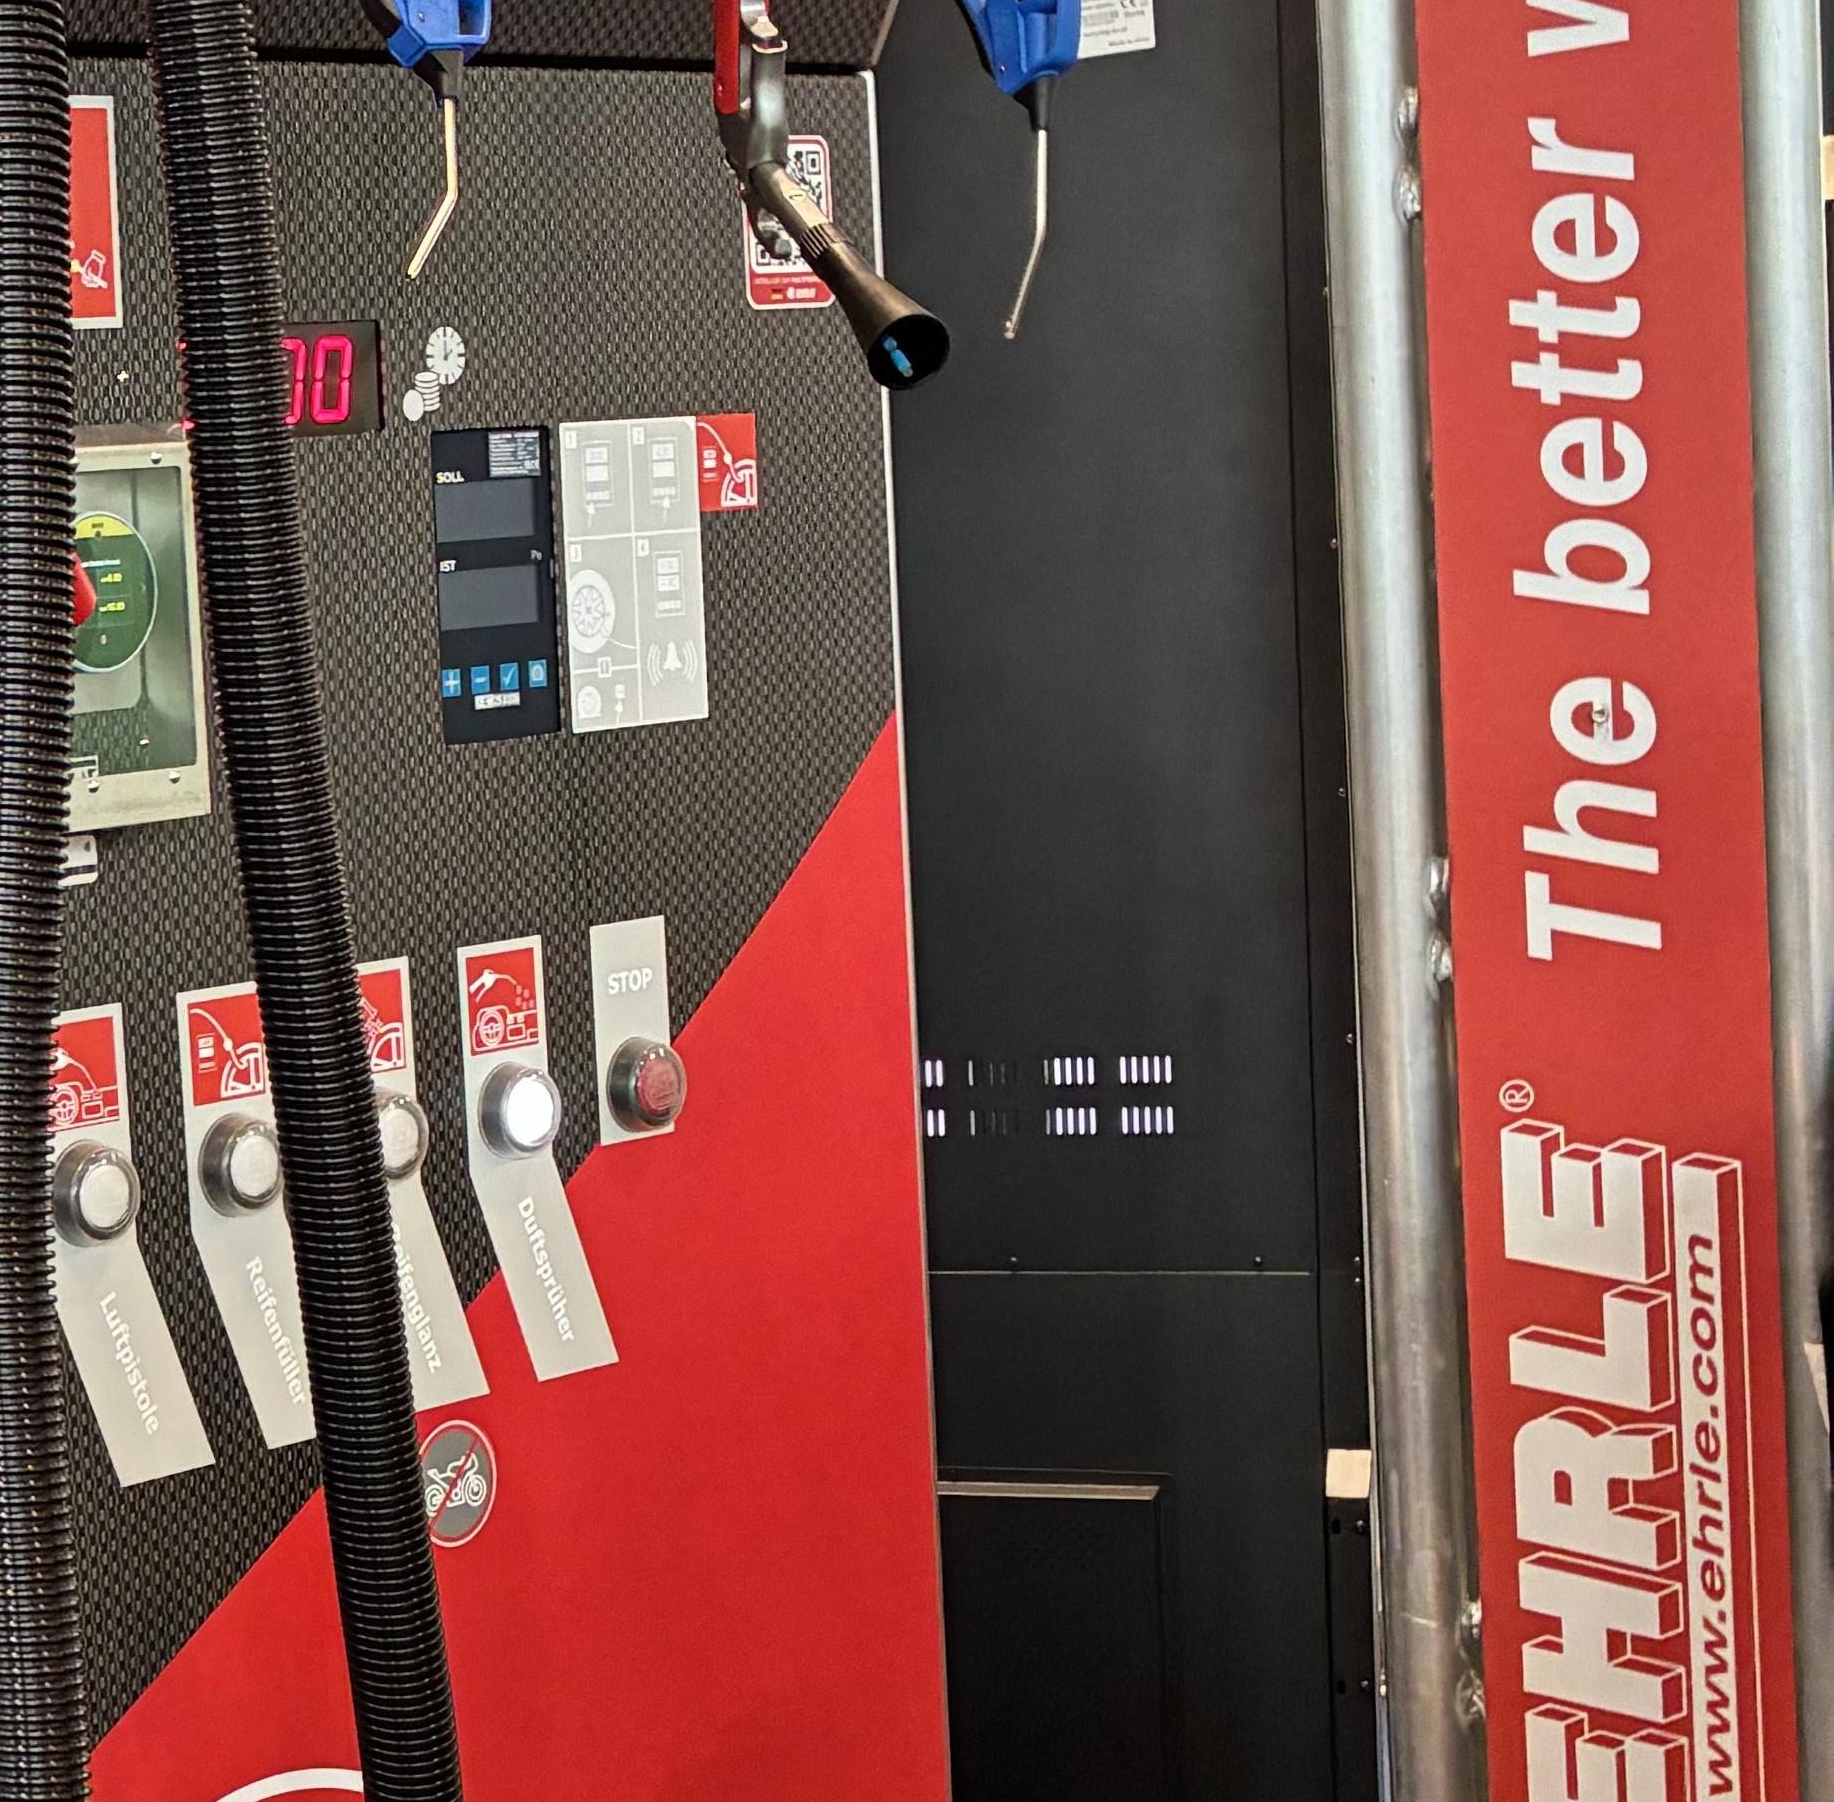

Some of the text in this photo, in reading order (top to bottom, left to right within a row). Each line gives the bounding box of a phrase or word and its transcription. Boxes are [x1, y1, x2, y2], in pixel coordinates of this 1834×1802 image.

[1507, 116, 1652, 615] better
[436, 470, 465, 484] SOLL
[1522, 675, 1663, 961] The
[607, 966, 654, 996] STOP
[246, 1255, 307, 1405] Reifenfüller
[517, 1195, 575, 1343] Duftsprüher
[99, 1291, 160, 1436] Luftpistole
[1686, 1231, 1735, 1799] www.ehrle.com
